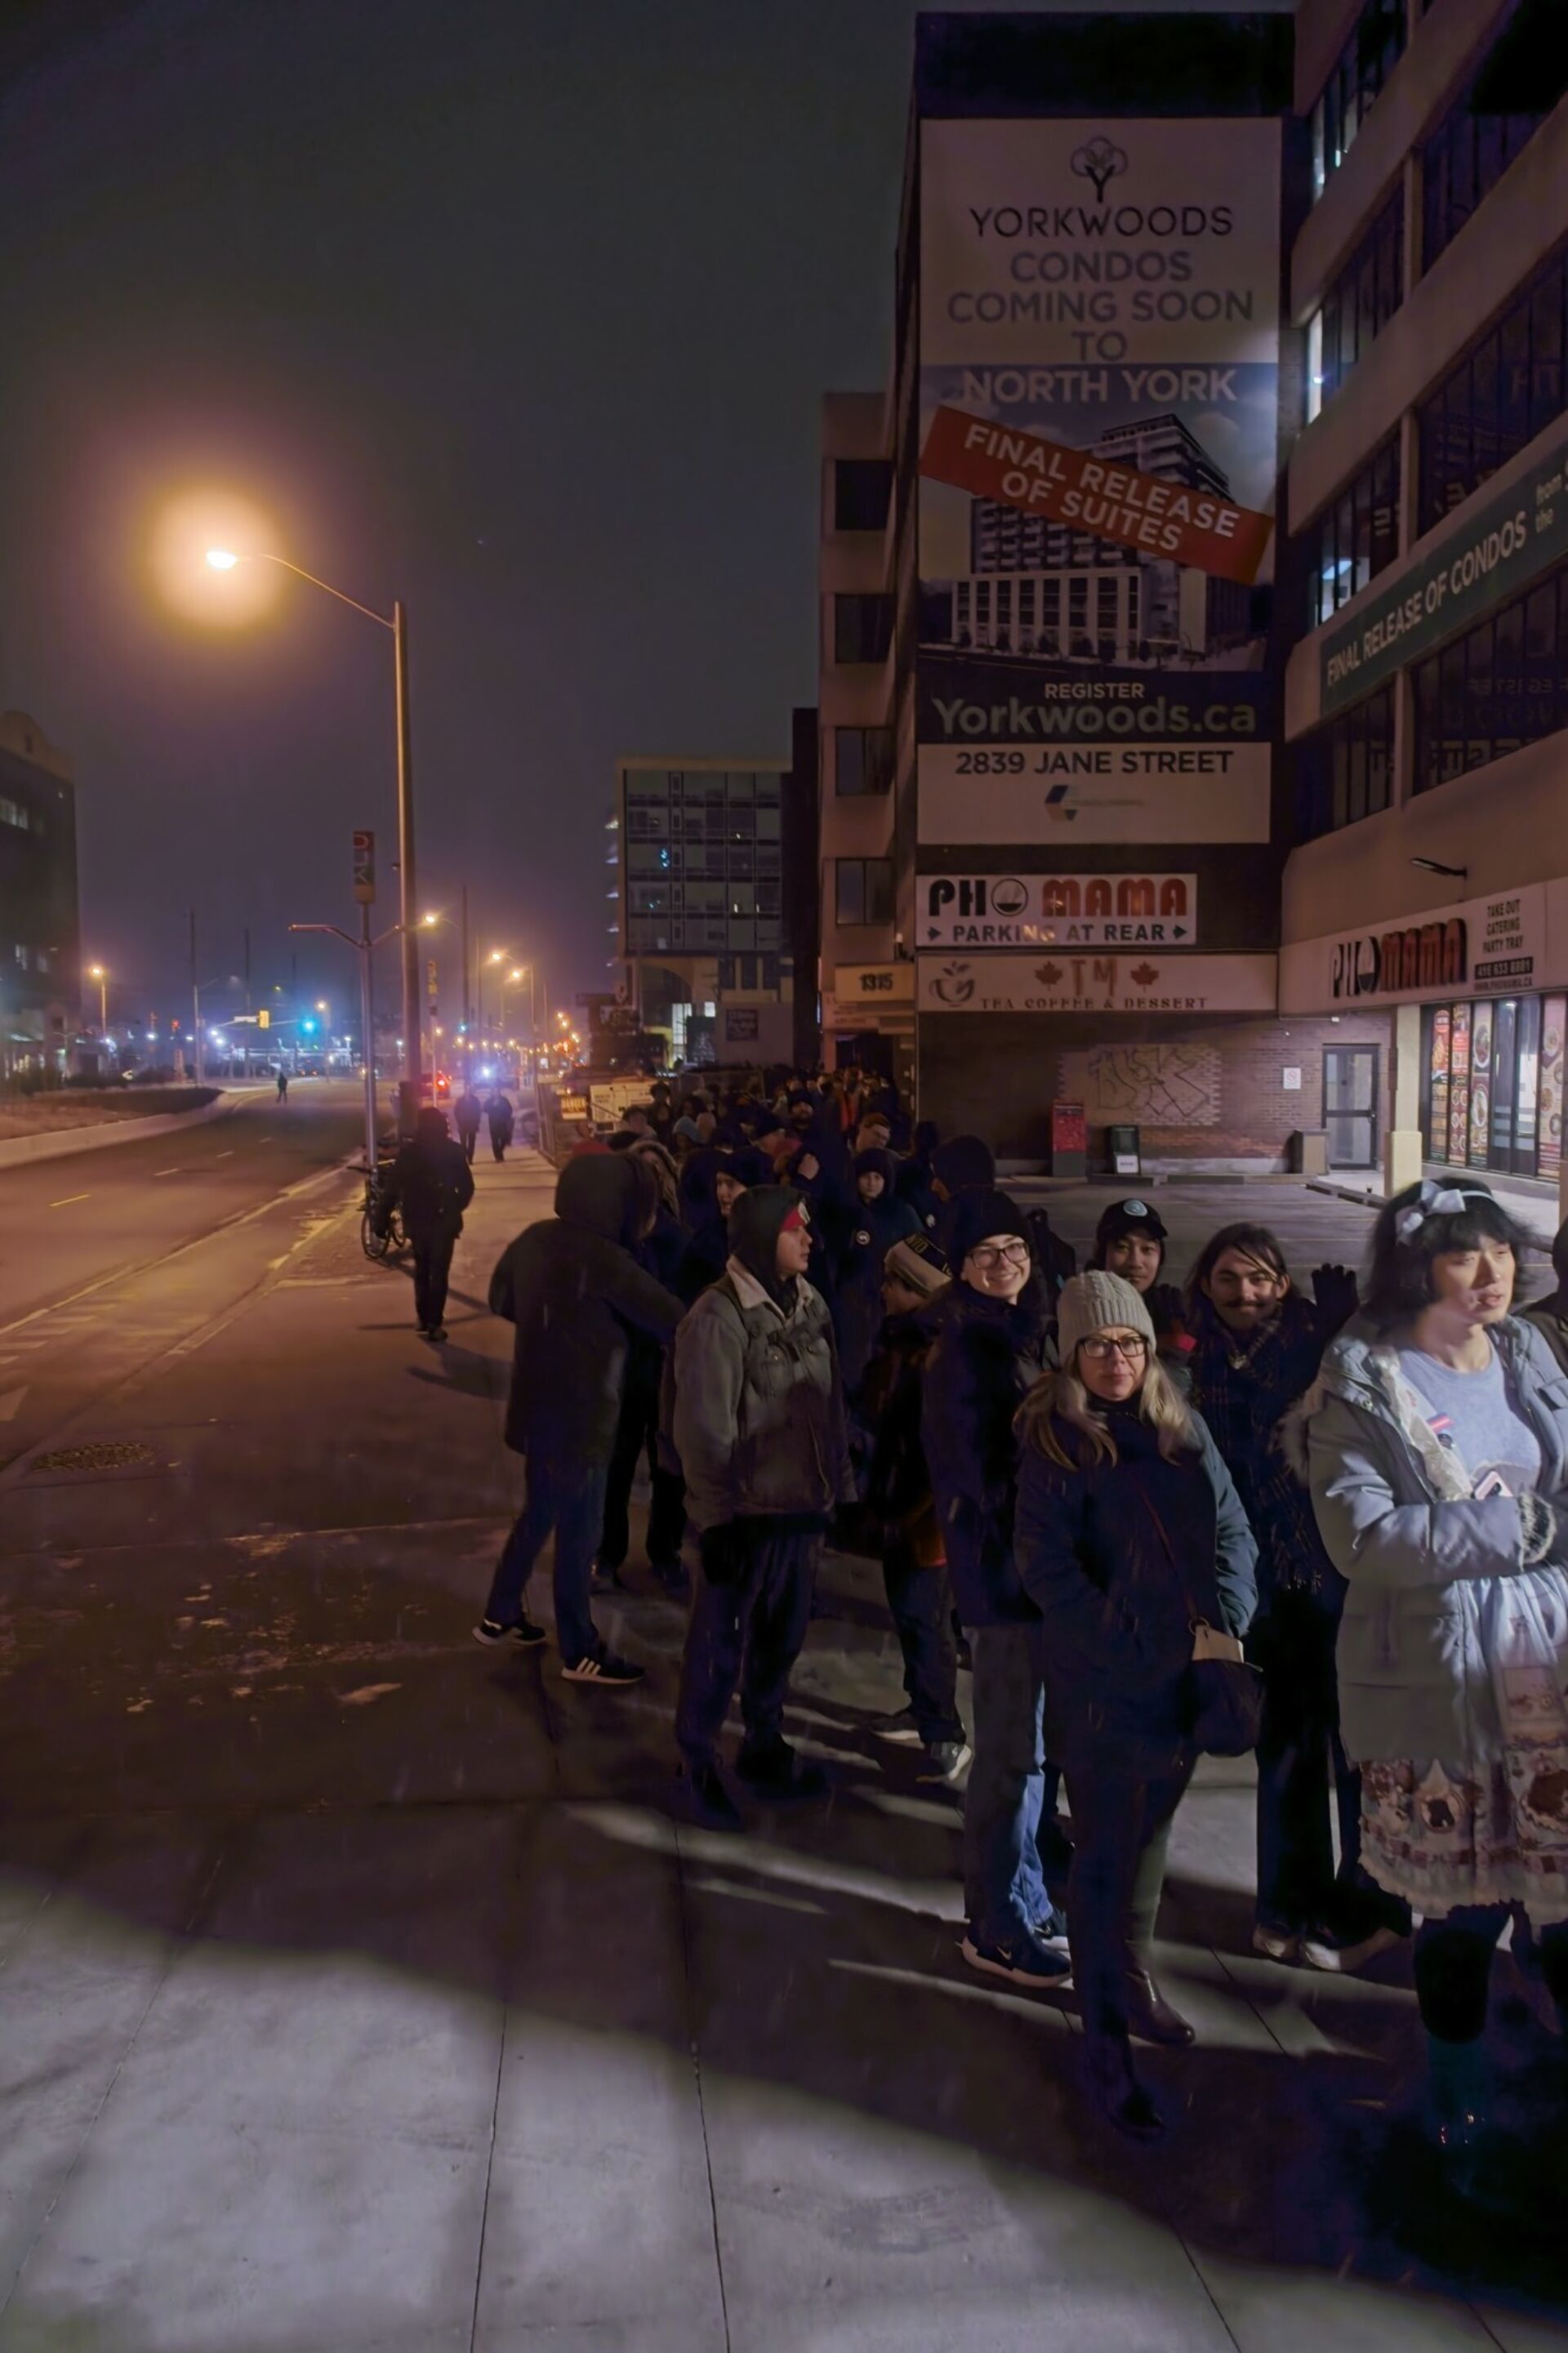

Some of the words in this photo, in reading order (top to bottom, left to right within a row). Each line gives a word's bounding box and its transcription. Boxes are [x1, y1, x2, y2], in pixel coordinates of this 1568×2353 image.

[969, 206, 1233, 238] YORKWOODS
[1010, 251, 1192, 283] CONDOS
[947, 291, 1116, 323] COMING
[1131, 290, 1254, 322] SOON
[1071, 332, 1128, 362] TO
[963, 370, 1107, 403] NORTH
[1122, 369, 1237, 402] YORK
[964, 423, 1066, 482] FINAL
[1078, 462, 1241, 539] RELEASE
[1001, 470, 1052, 505] OF
[1060, 491, 1183, 551] SUITES
[1327, 640, 1361, 687] FINAL
[1363, 590, 1423, 661] RELEASE
[1425, 571, 1448, 614] OF
[1450, 510, 1527, 595] CONDOS
[1044, 682, 1146, 700] REGISTER
[932, 695, 1257, 735] Yorkwoods.ca
[955, 751, 1026, 774] 2839
[1034, 751, 1112, 774] JANE
[1121, 751, 1234, 774] STREET
[1042, 878, 1187, 916] MAMA
[1487, 902, 1504, 918] TAKE
[1505, 898, 1521, 915] OUT
[952, 924, 1057, 941] PARKING
[1067, 924, 1094, 941] AT
[1104, 924, 1165, 941] REAR
[1486, 916, 1521, 936] CATERING
[1379, 918, 1468, 992] MAMA
[1483, 938, 1503, 955] PARTY
[1505, 935, 1524, 950] TRAY
[1071, 957, 1118, 998] TM
[981, 997, 1014, 1010] TEA
[1024, 997, 1094, 1010] COFFEE
[1103, 997, 1114, 1010] &
[1124, 996, 1209, 1010] DESSERT
